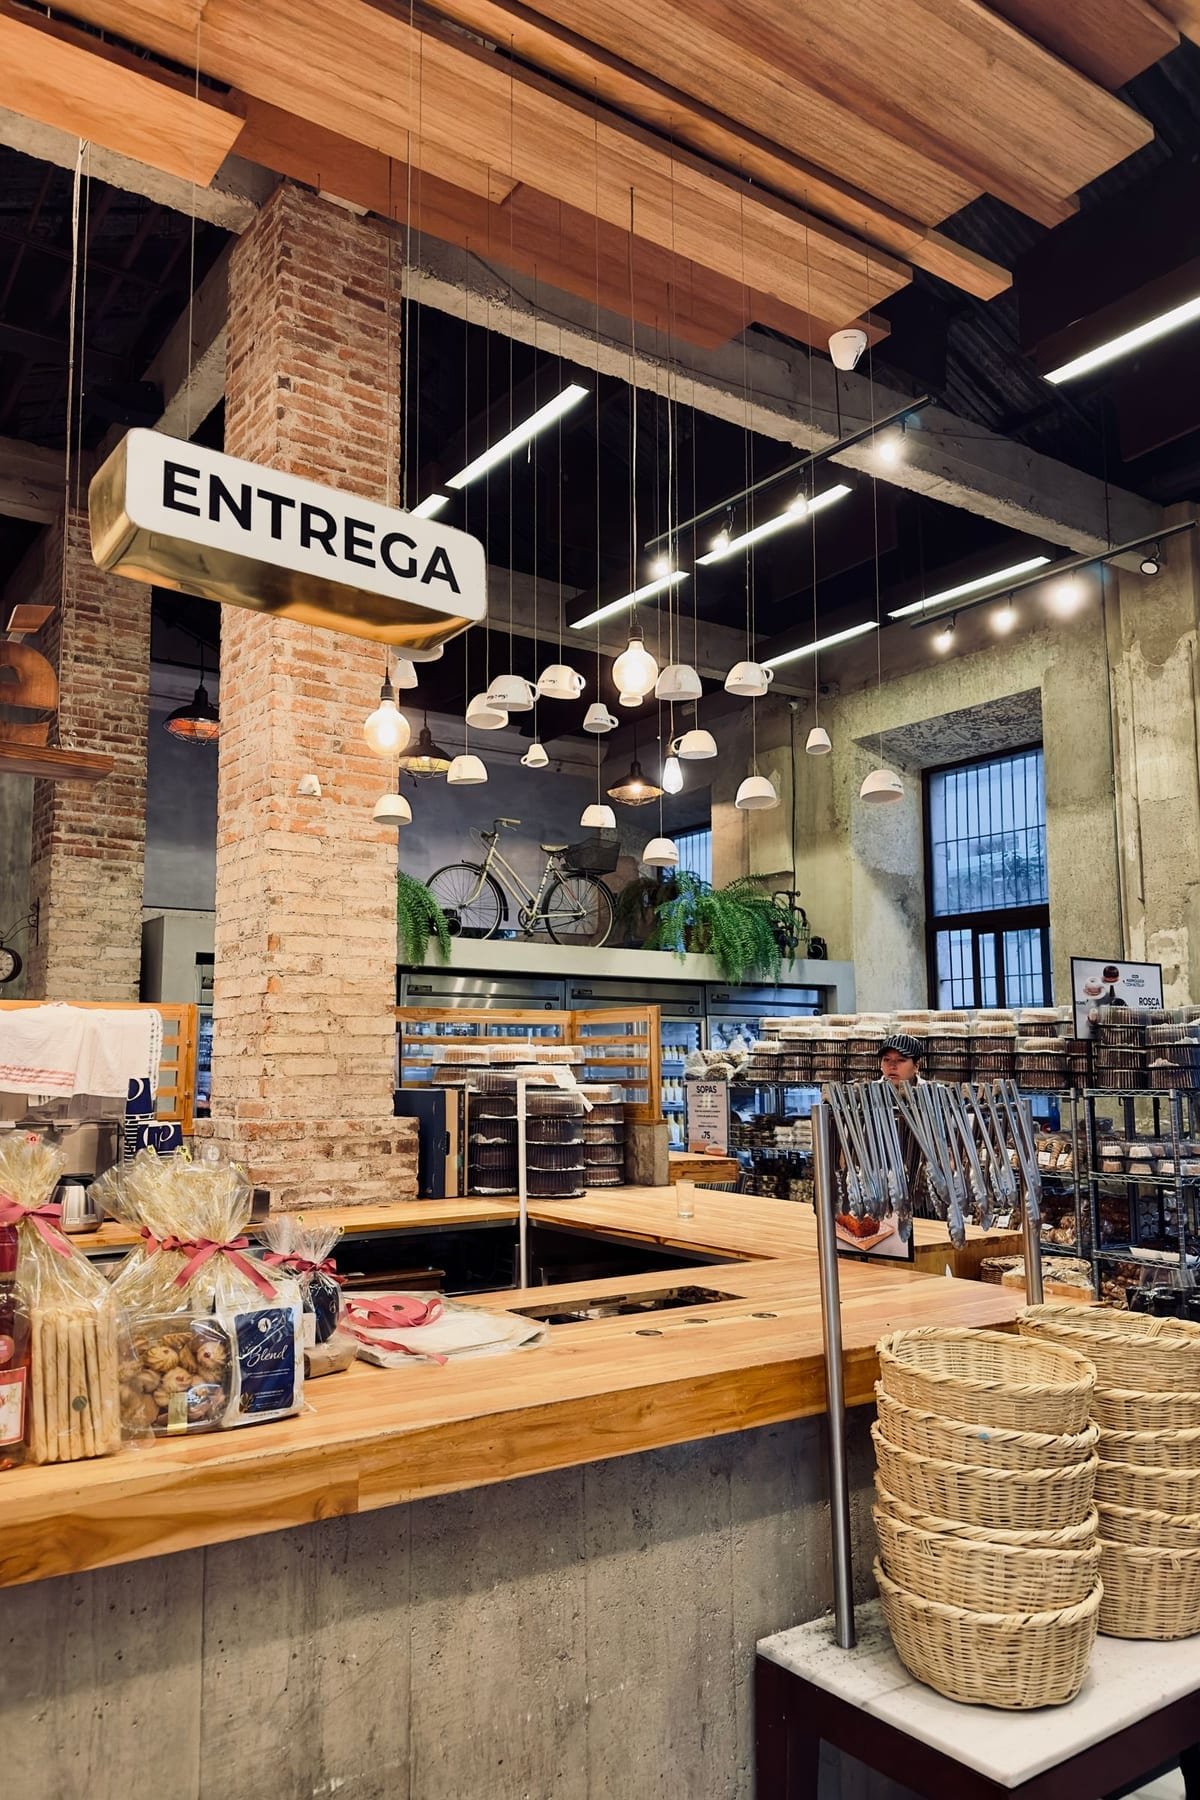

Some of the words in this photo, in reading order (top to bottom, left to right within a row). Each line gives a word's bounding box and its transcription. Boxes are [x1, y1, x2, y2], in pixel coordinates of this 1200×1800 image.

[162, 459, 462, 595] ENTREGA
[1138, 997, 1160, 1006] ROSCA
[696, 1085, 717, 1094] SOPAS
[246, 1344, 289, 1368] Blend
